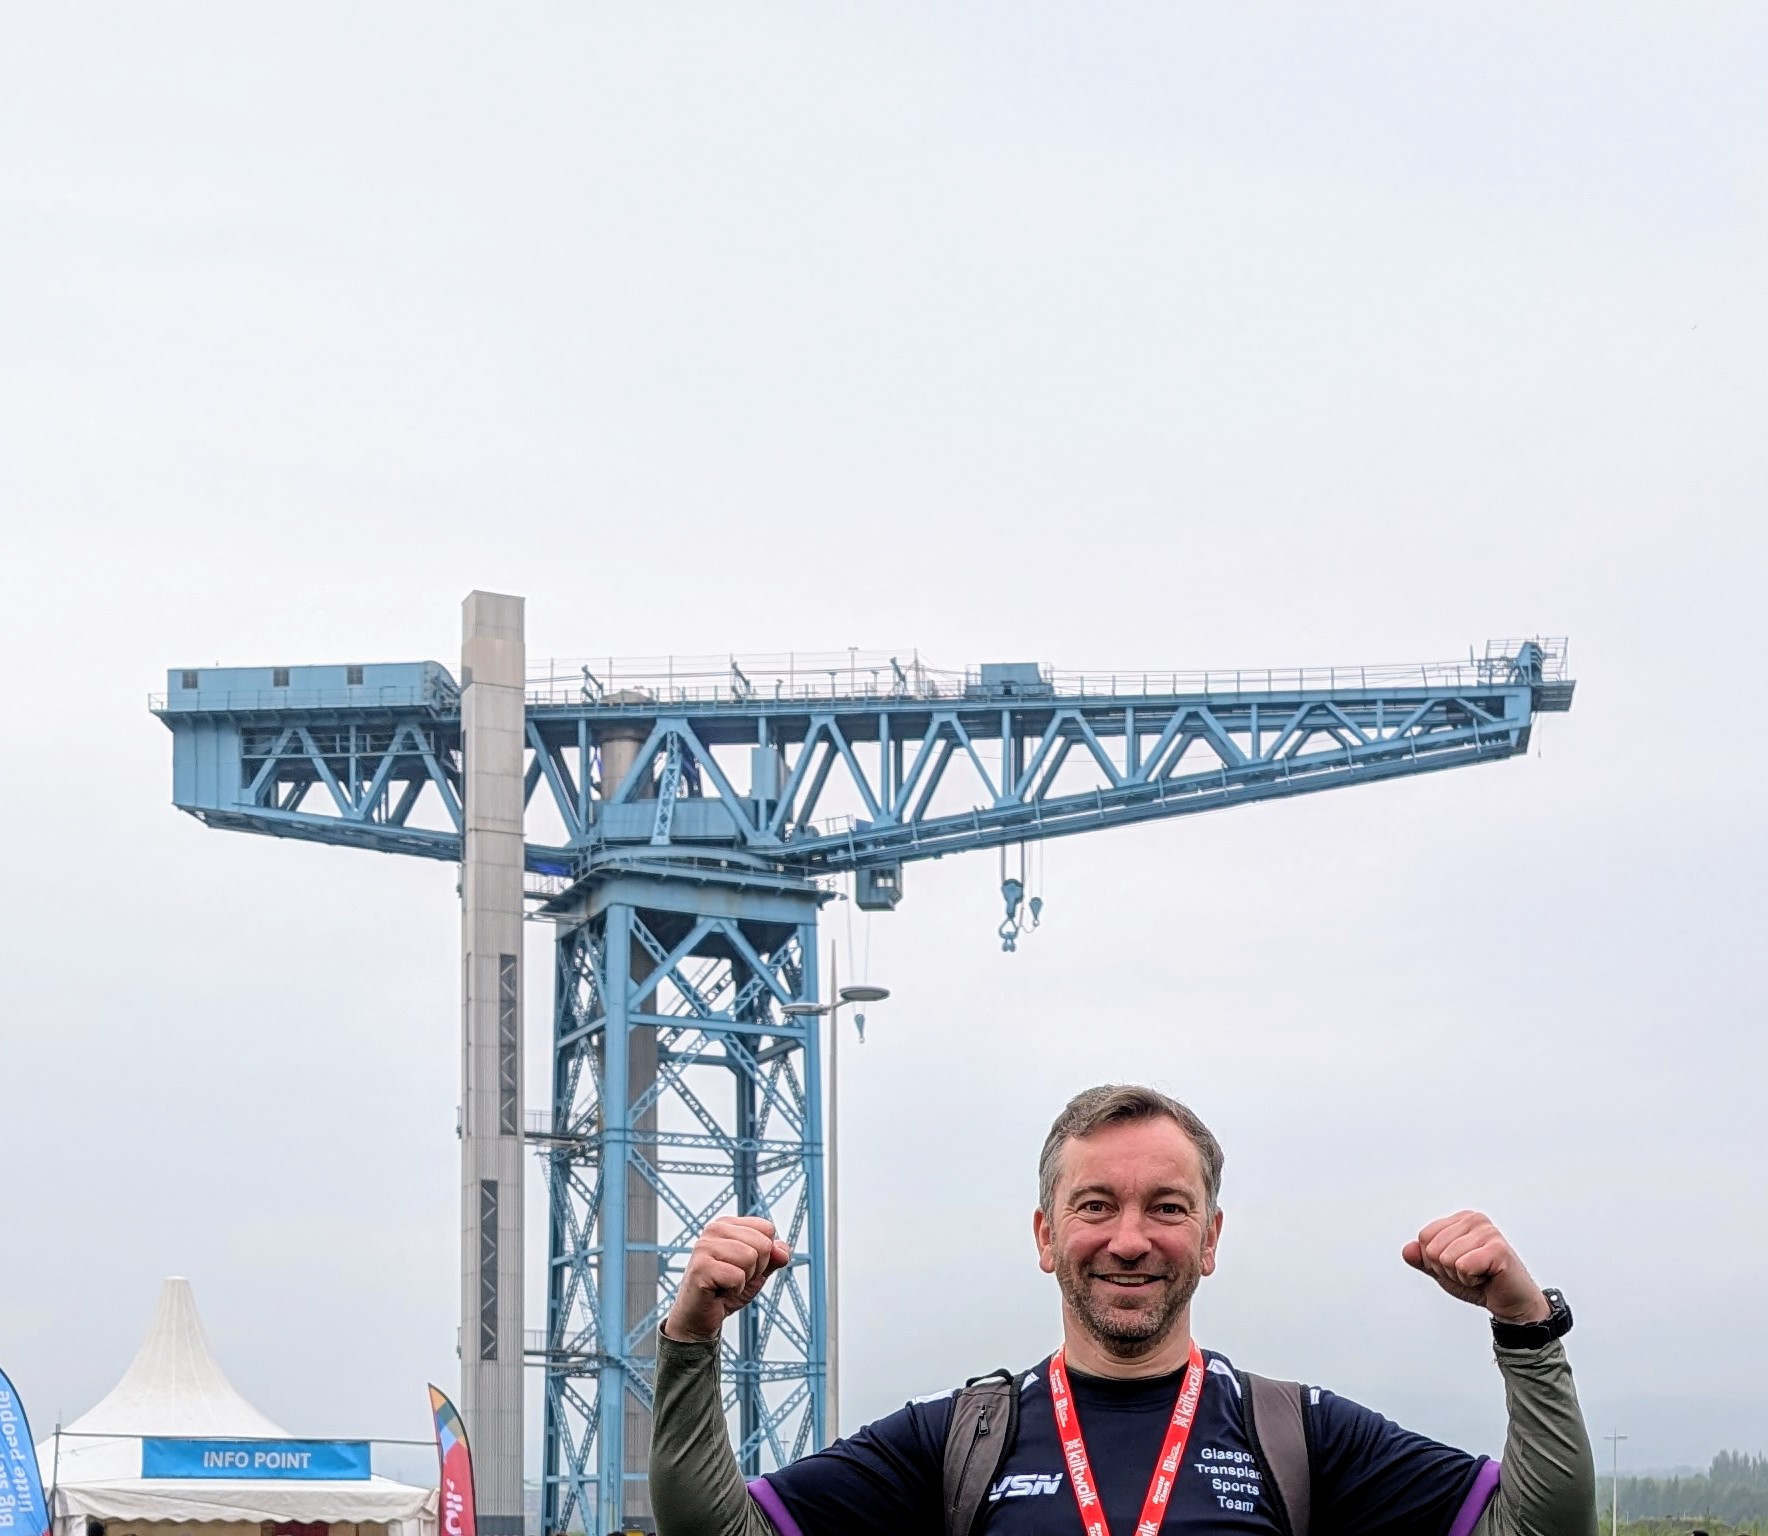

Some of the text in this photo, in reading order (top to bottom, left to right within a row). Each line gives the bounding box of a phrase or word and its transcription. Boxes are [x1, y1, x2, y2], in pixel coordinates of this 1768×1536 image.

[1176, 1363, 1202, 1416] kiltwalk
[203, 1451, 311, 1469] INFO POINT
[1067, 1449, 1097, 1508] kiltwalk
[1194, 1464, 1262, 1480] Transplan
[13, 1466, 34, 1514] little
[1212, 1478, 1260, 1496] Sports
[1217, 1495, 1254, 1513] Team
